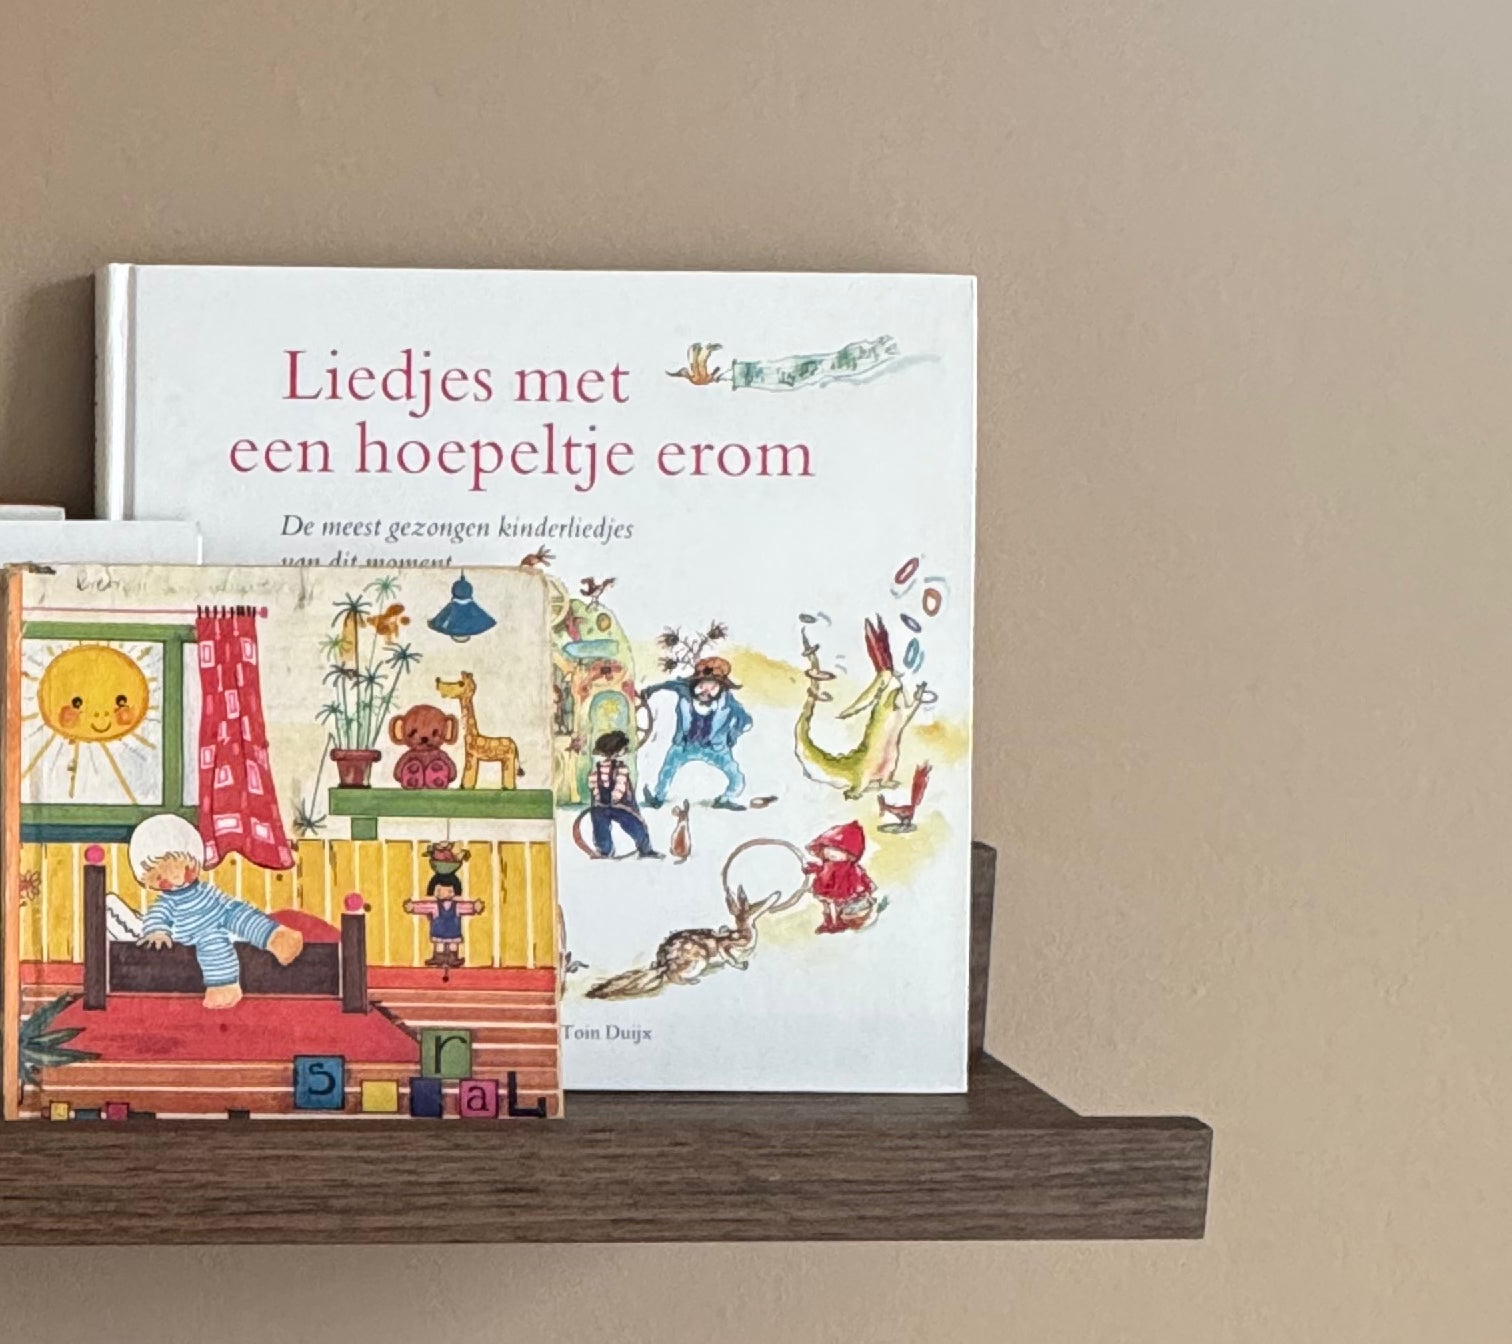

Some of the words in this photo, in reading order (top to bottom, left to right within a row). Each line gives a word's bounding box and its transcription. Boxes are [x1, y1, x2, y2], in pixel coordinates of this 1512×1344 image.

[283, 348, 493, 420] Liedjes
[514, 364, 630, 404] met
[229, 439, 332, 473] een
[355, 420, 634, 492] hoepeltje
[657, 442, 813, 477] erom
[280, 514, 315, 536] De
[321, 519, 382, 537] meest
[385, 521, 490, 544] gezongen
[498, 514, 634, 543] kinderliedjes
[605, 1024, 652, 1044] Duijx
